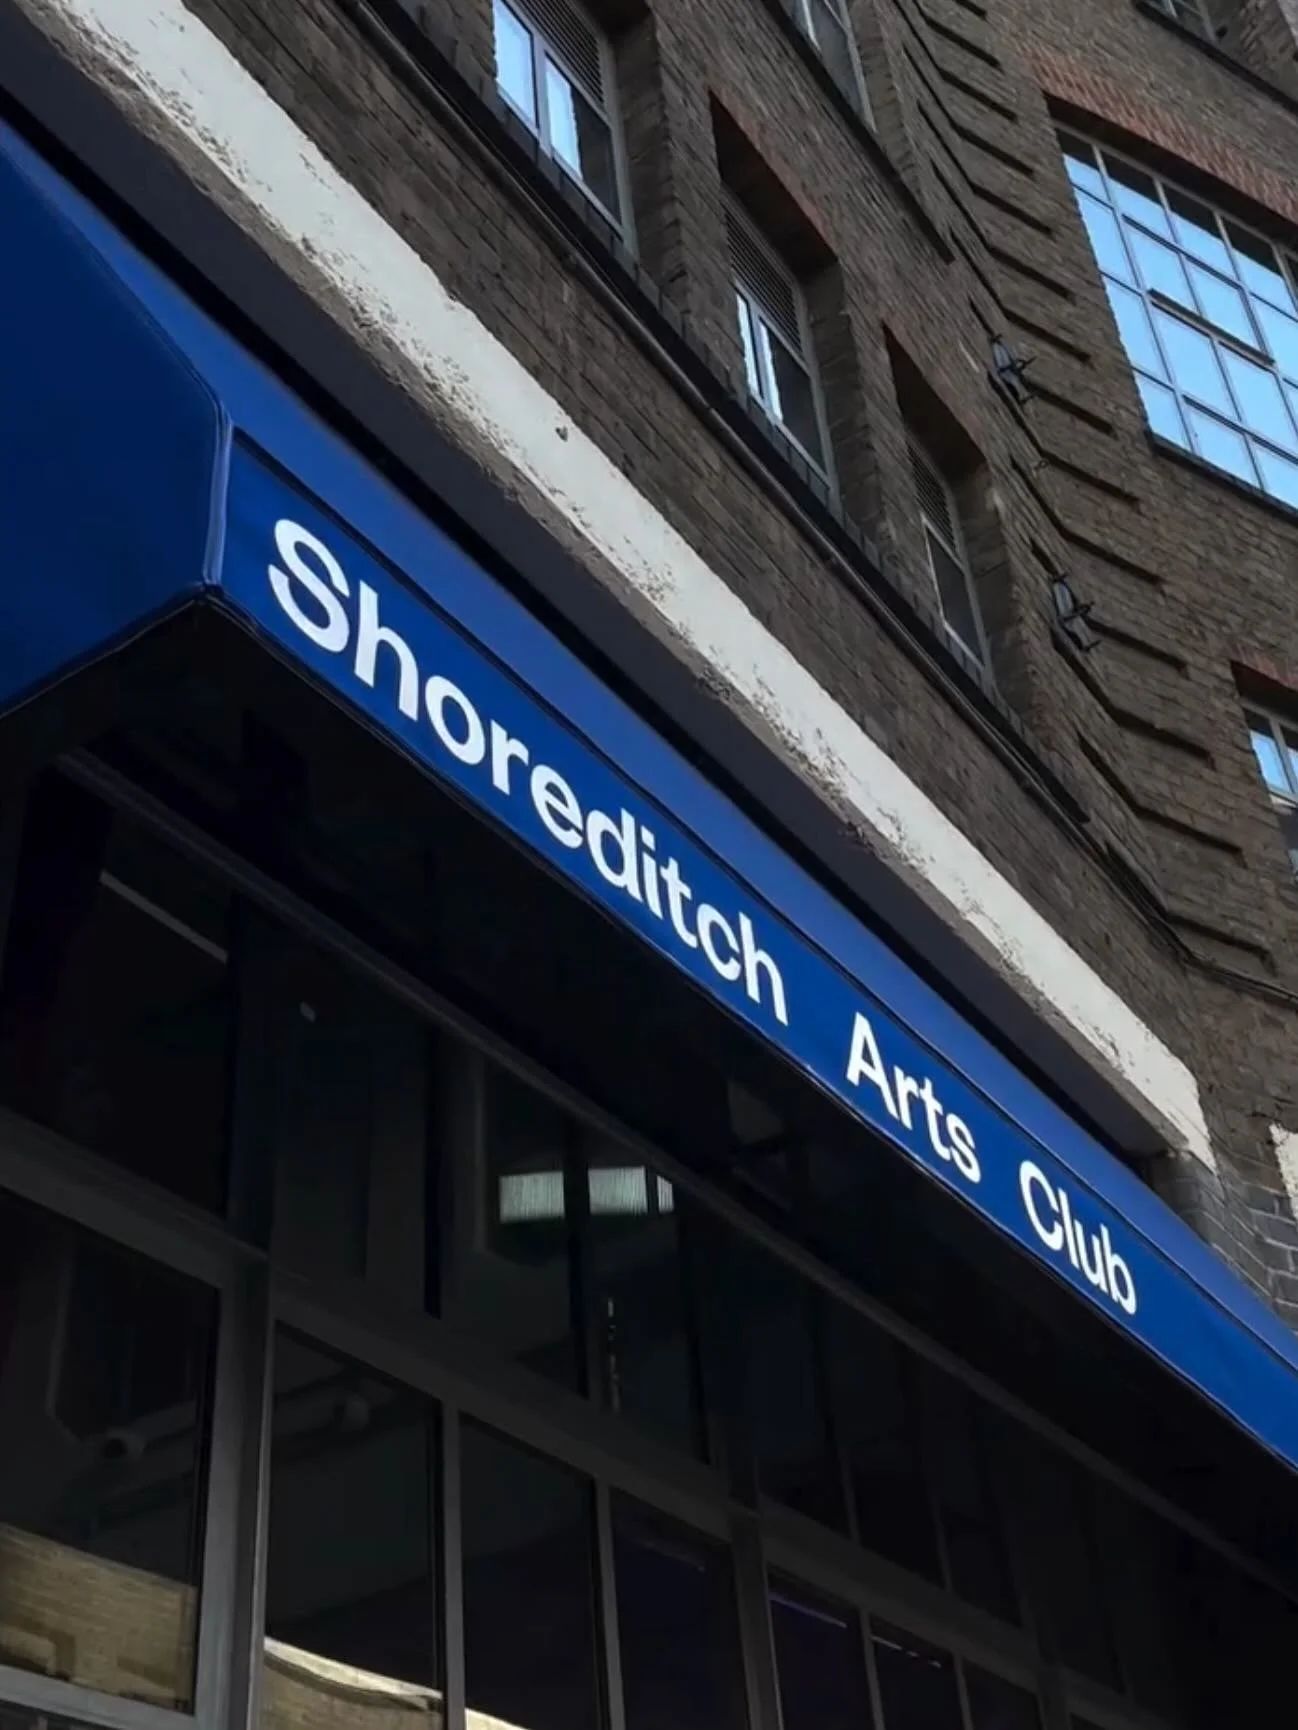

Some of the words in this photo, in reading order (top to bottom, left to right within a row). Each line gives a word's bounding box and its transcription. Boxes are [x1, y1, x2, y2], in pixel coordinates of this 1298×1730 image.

[268, 519, 788, 1026] Shoreditch
[846, 1012, 981, 1183] Arts
[1019, 1160, 1137, 1315] Club
